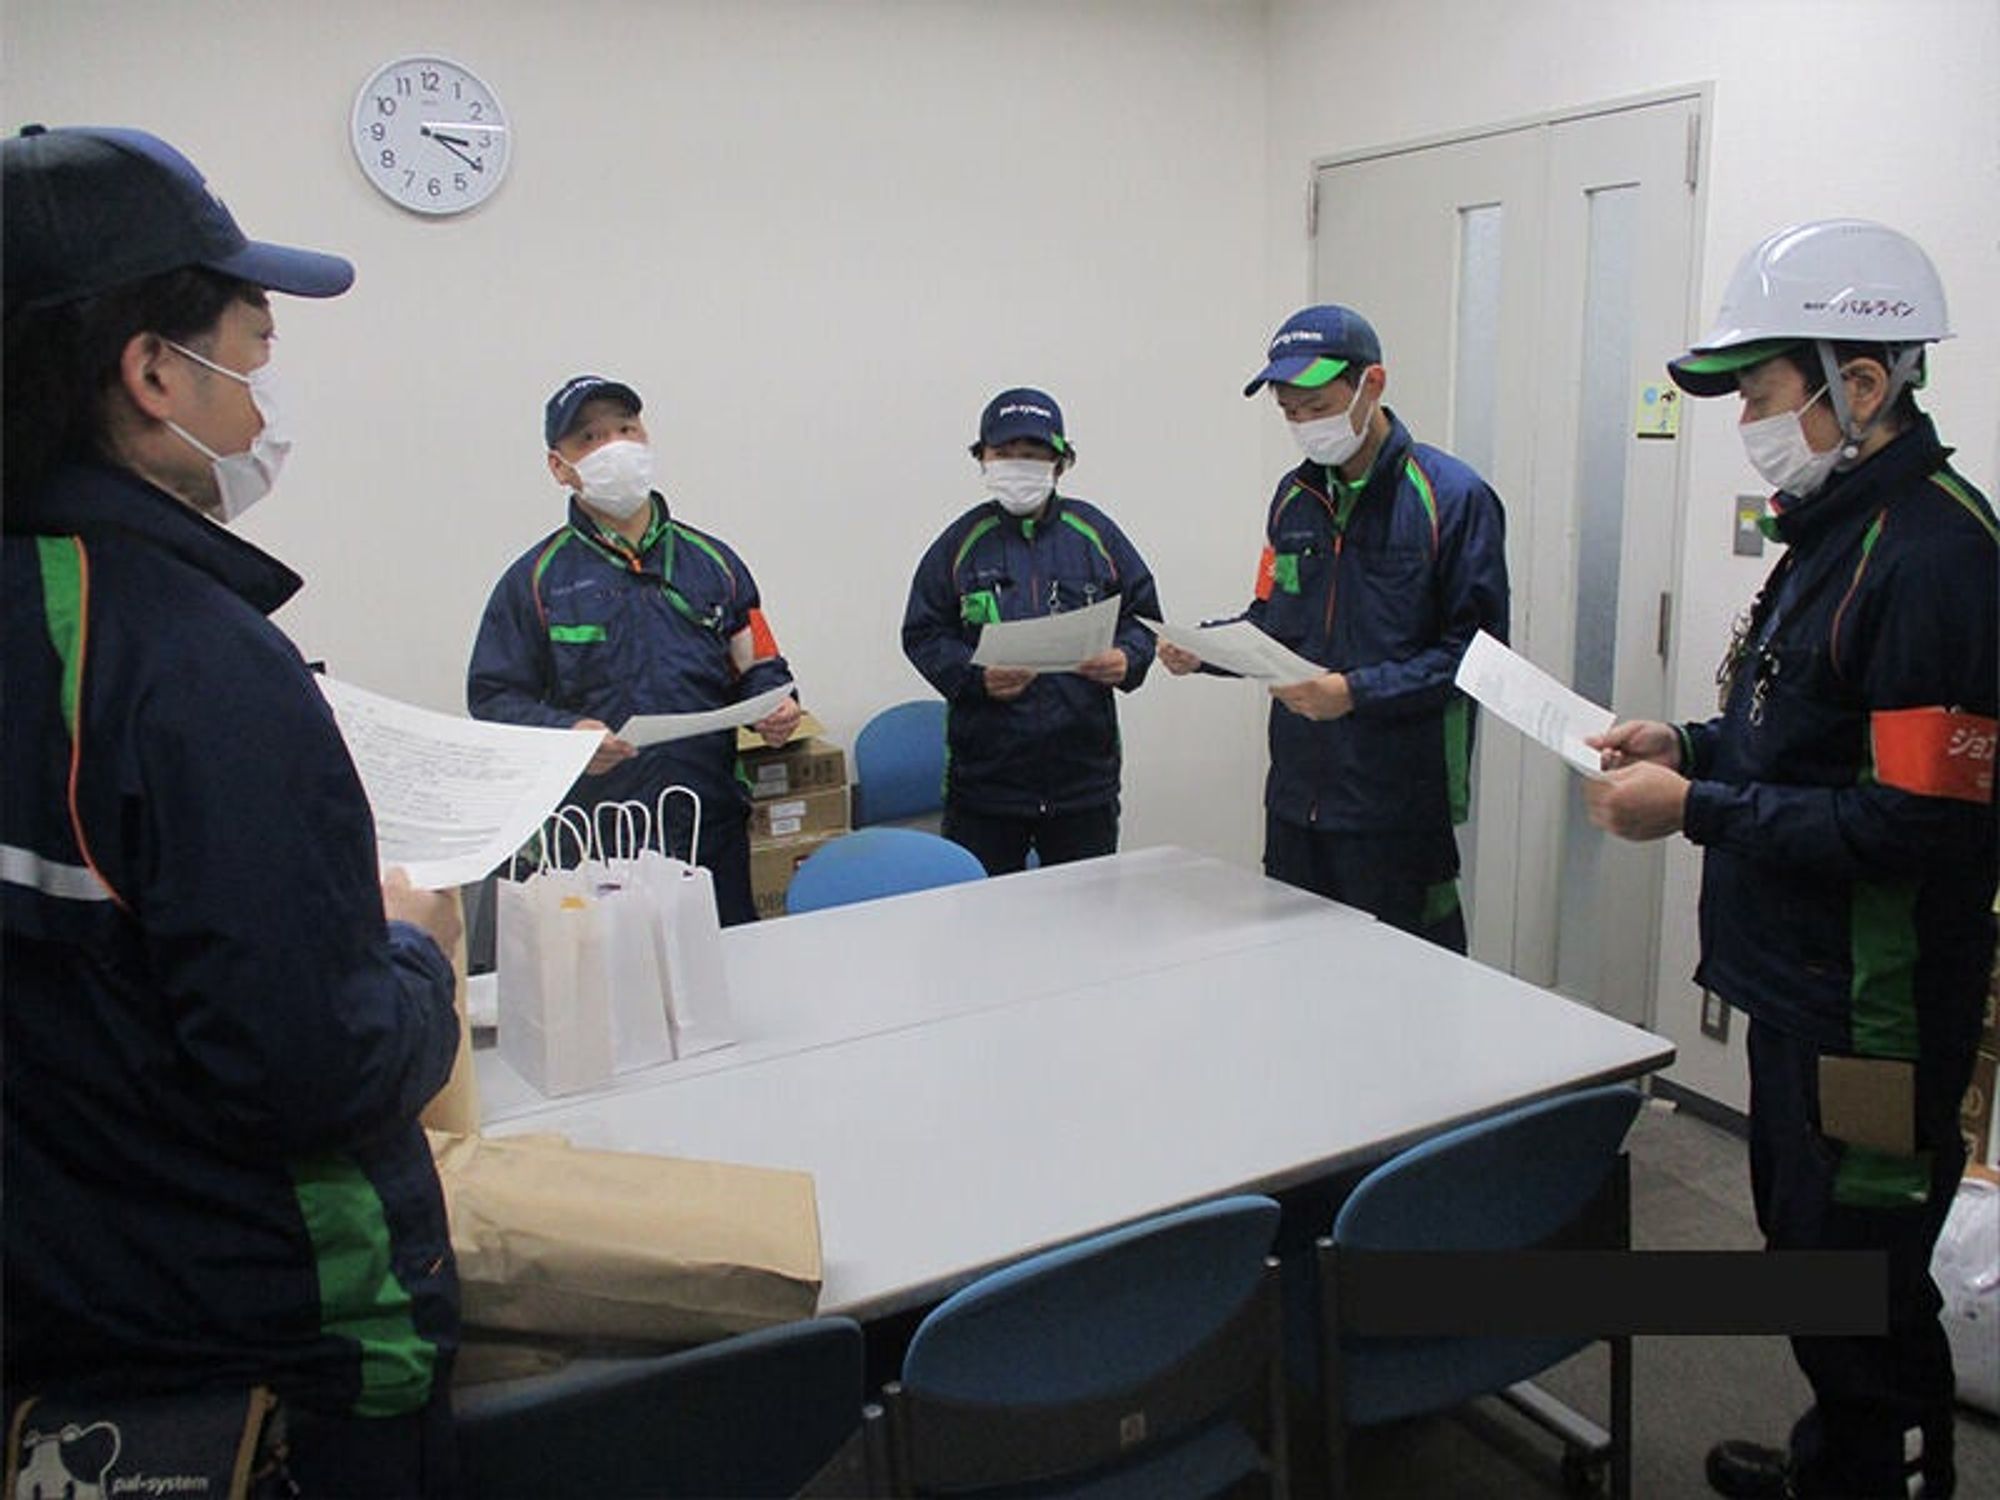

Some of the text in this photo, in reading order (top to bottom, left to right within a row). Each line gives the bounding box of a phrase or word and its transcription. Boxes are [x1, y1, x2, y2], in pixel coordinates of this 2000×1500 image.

[396, 76, 412, 97] 11
[420, 71, 440, 92] 12
[452, 81, 462, 100] 1
[377, 96, 397, 117] 10
[469, 101, 483, 122] 2
[370, 122, 385, 142] 9
[477, 130, 492, 149] 3
[380, 149, 396, 169] 8
[402, 169, 417, 189] 7
[426, 177, 442, 197] 6
[453, 172, 468, 192] 5
[112, 1472, 209, 1496] pal-system
